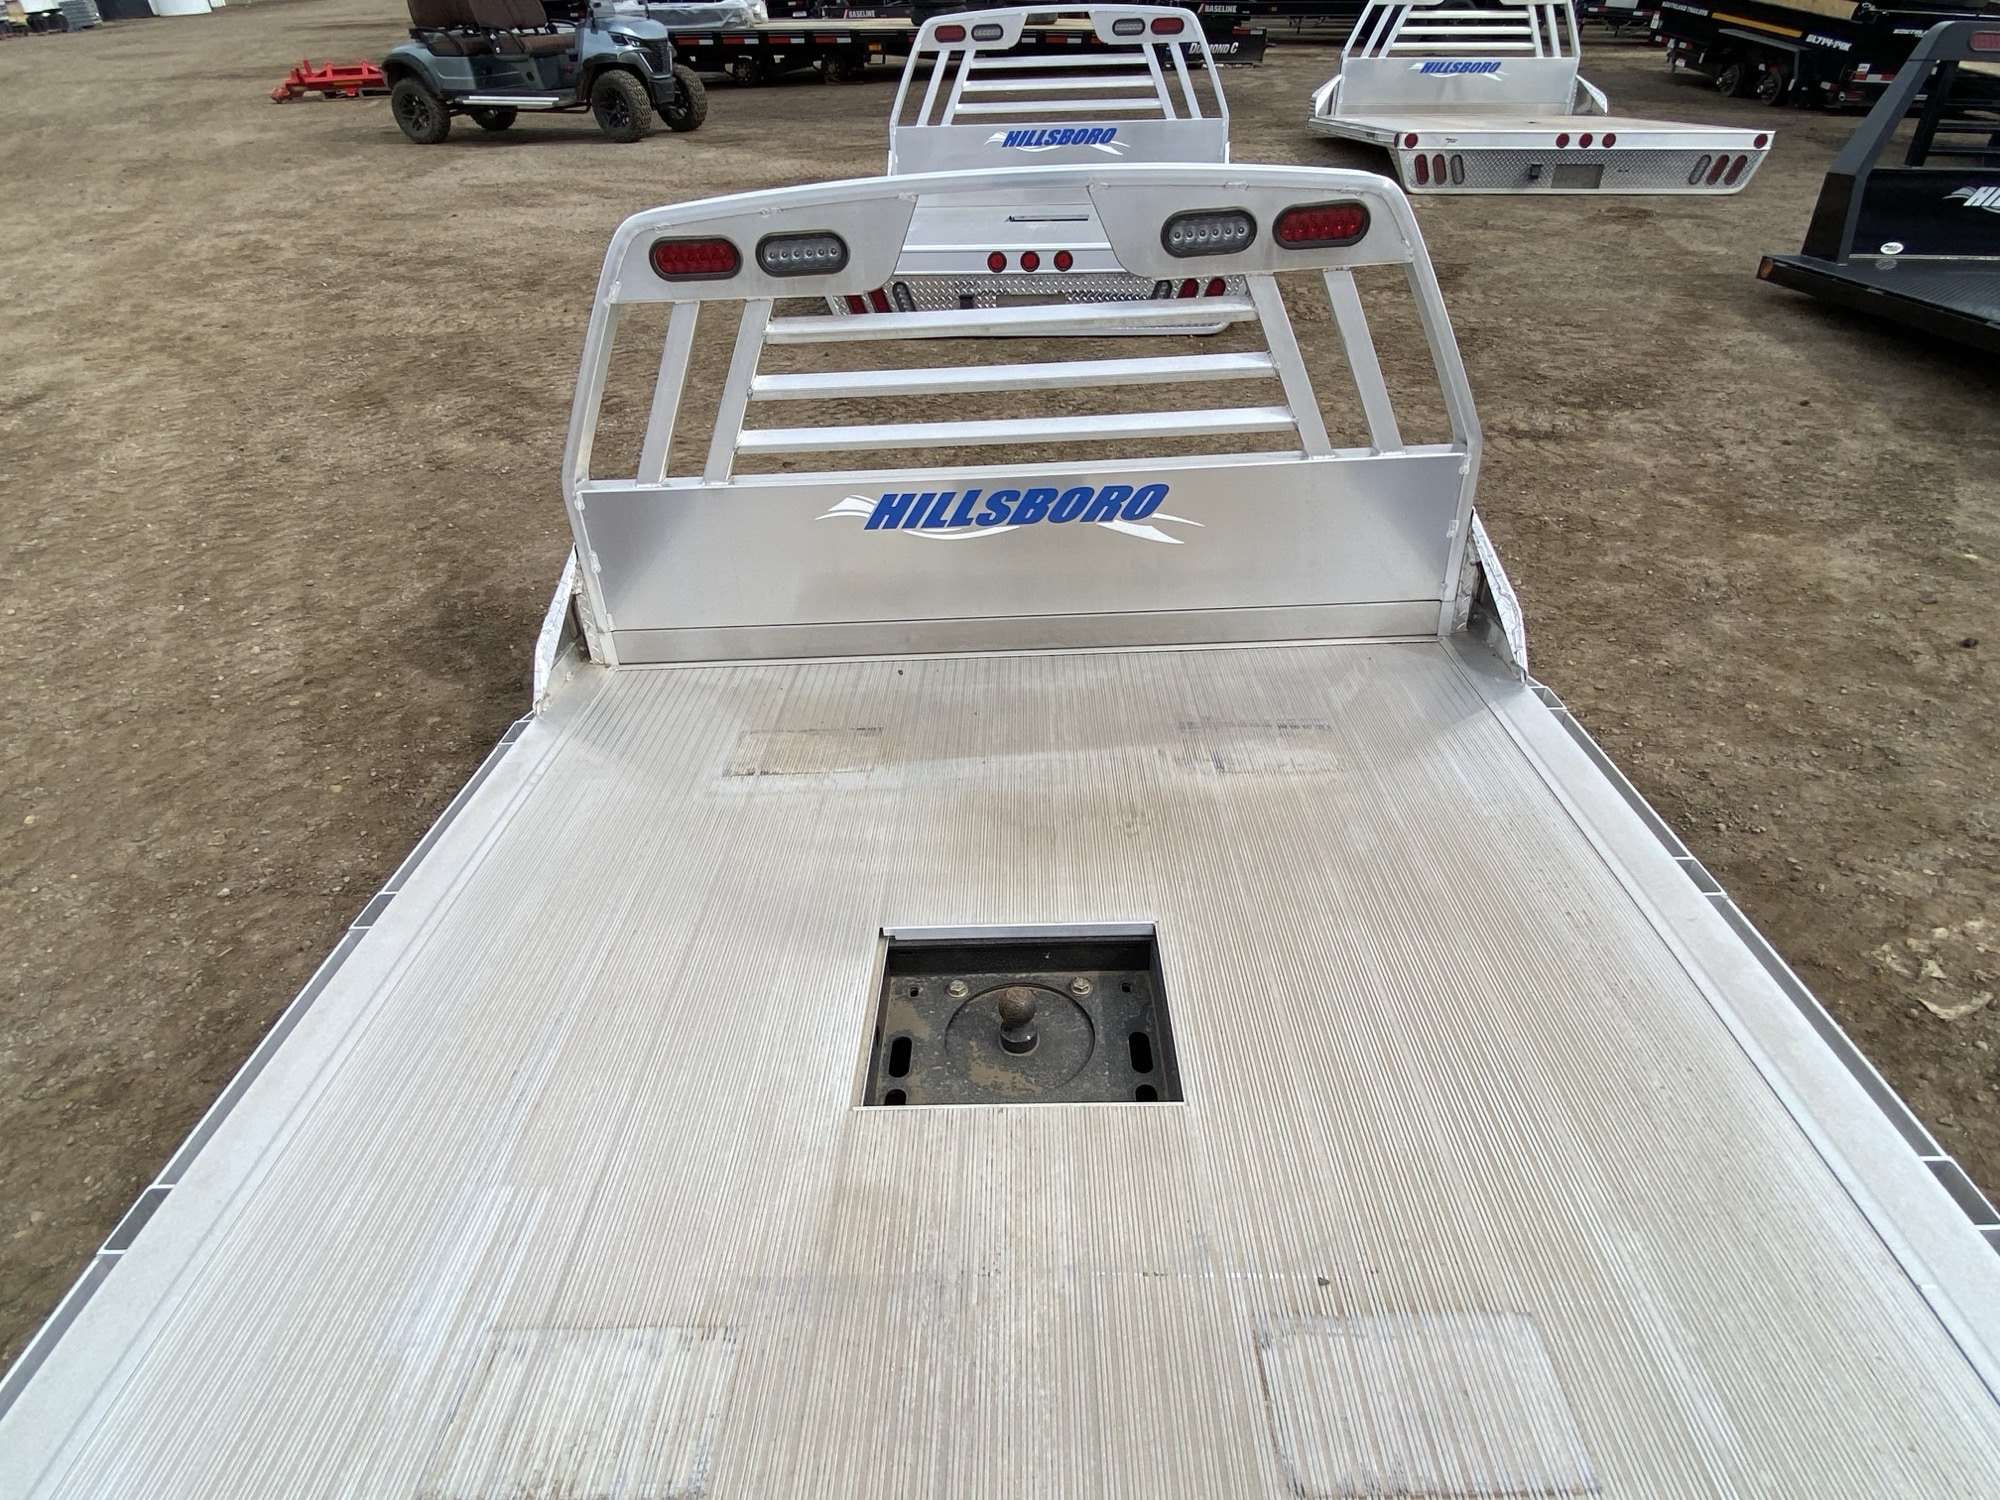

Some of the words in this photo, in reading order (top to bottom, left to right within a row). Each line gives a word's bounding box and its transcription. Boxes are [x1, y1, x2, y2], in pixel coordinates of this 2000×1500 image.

[848, 10, 876, 18] BASELINE
[1203, 5, 1238, 13] BASELINE
[1230, 42, 1239, 54] C
[1419, 61, 1502, 74] HILLSBORO
[1001, 127, 1118, 148] HILLSBORO
[863, 483, 1171, 531] HILLSBORO
